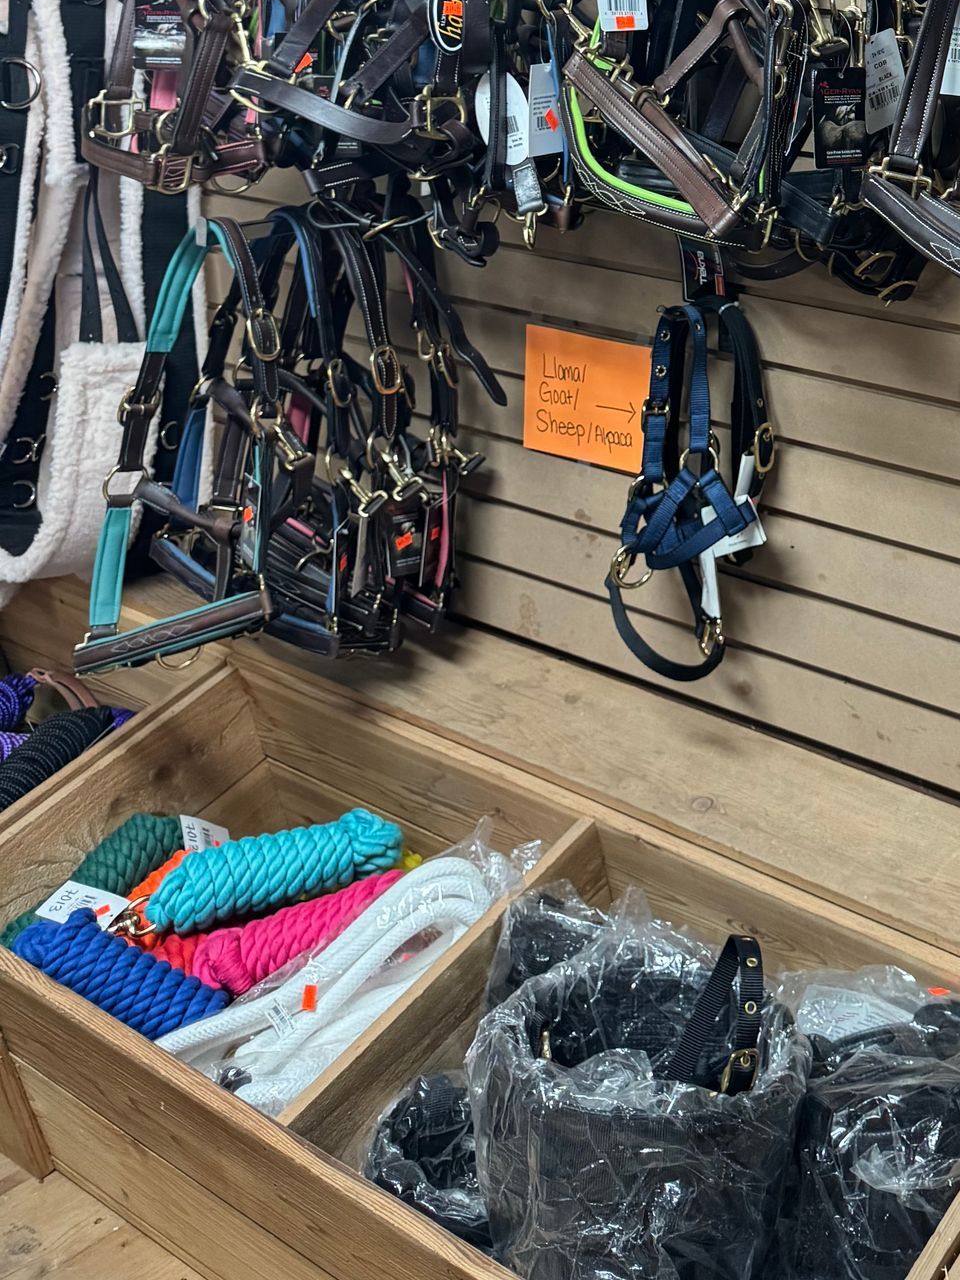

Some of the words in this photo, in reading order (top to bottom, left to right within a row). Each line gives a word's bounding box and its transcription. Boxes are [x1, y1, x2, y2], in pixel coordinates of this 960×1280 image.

[543, 353, 587, 383] Llama/
[539, 381, 579, 410] Goat/
[536, 409, 632, 453] Sheep/Alpaca
